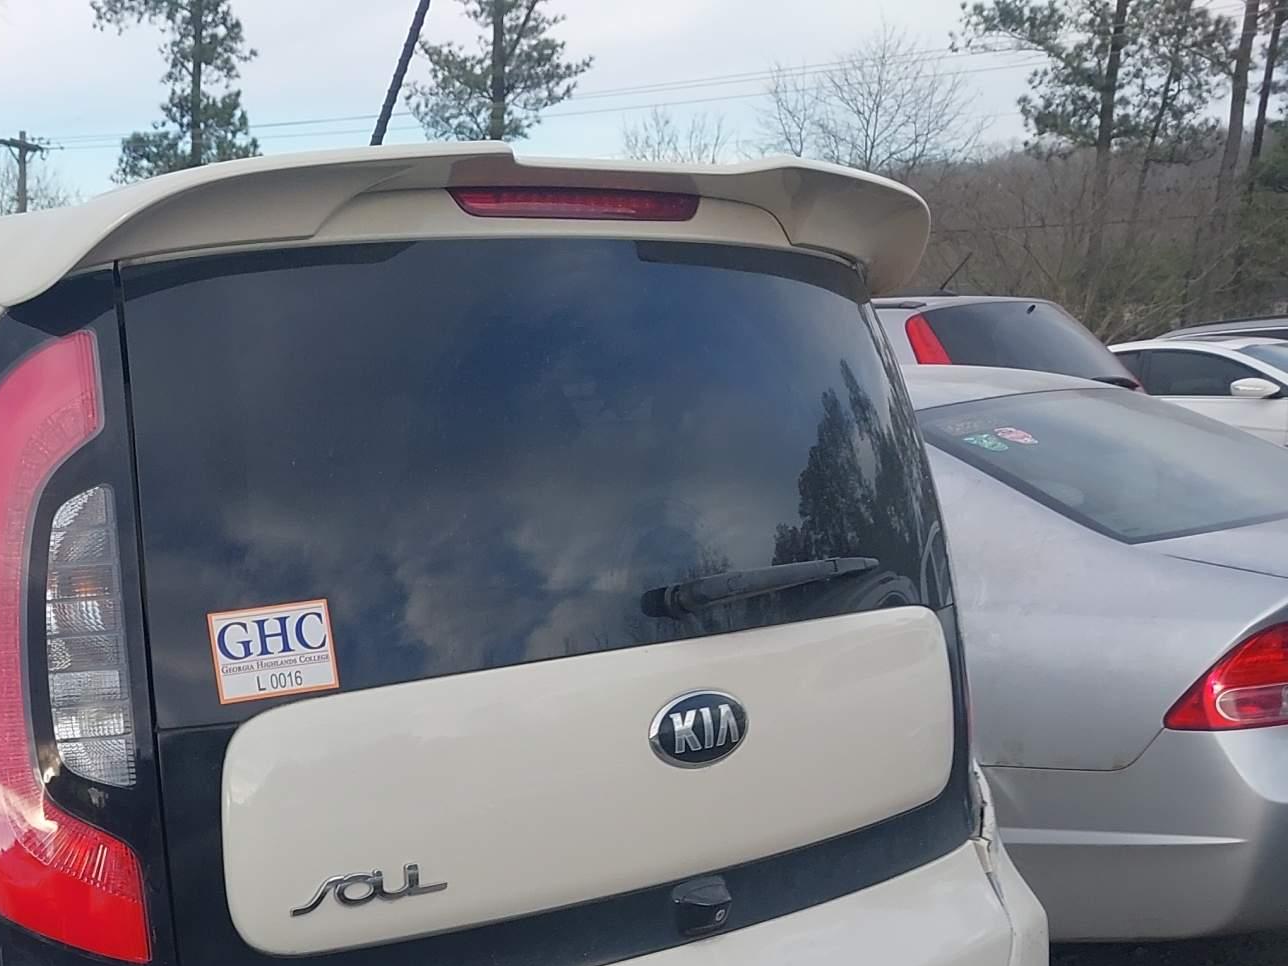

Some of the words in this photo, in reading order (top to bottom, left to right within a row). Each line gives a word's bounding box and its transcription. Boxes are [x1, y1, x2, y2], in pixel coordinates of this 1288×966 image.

[217, 612, 327, 661] GHC
[256, 675, 266, 691] L
[270, 670, 303, 689] 0016
[669, 703, 740, 754] KIA
